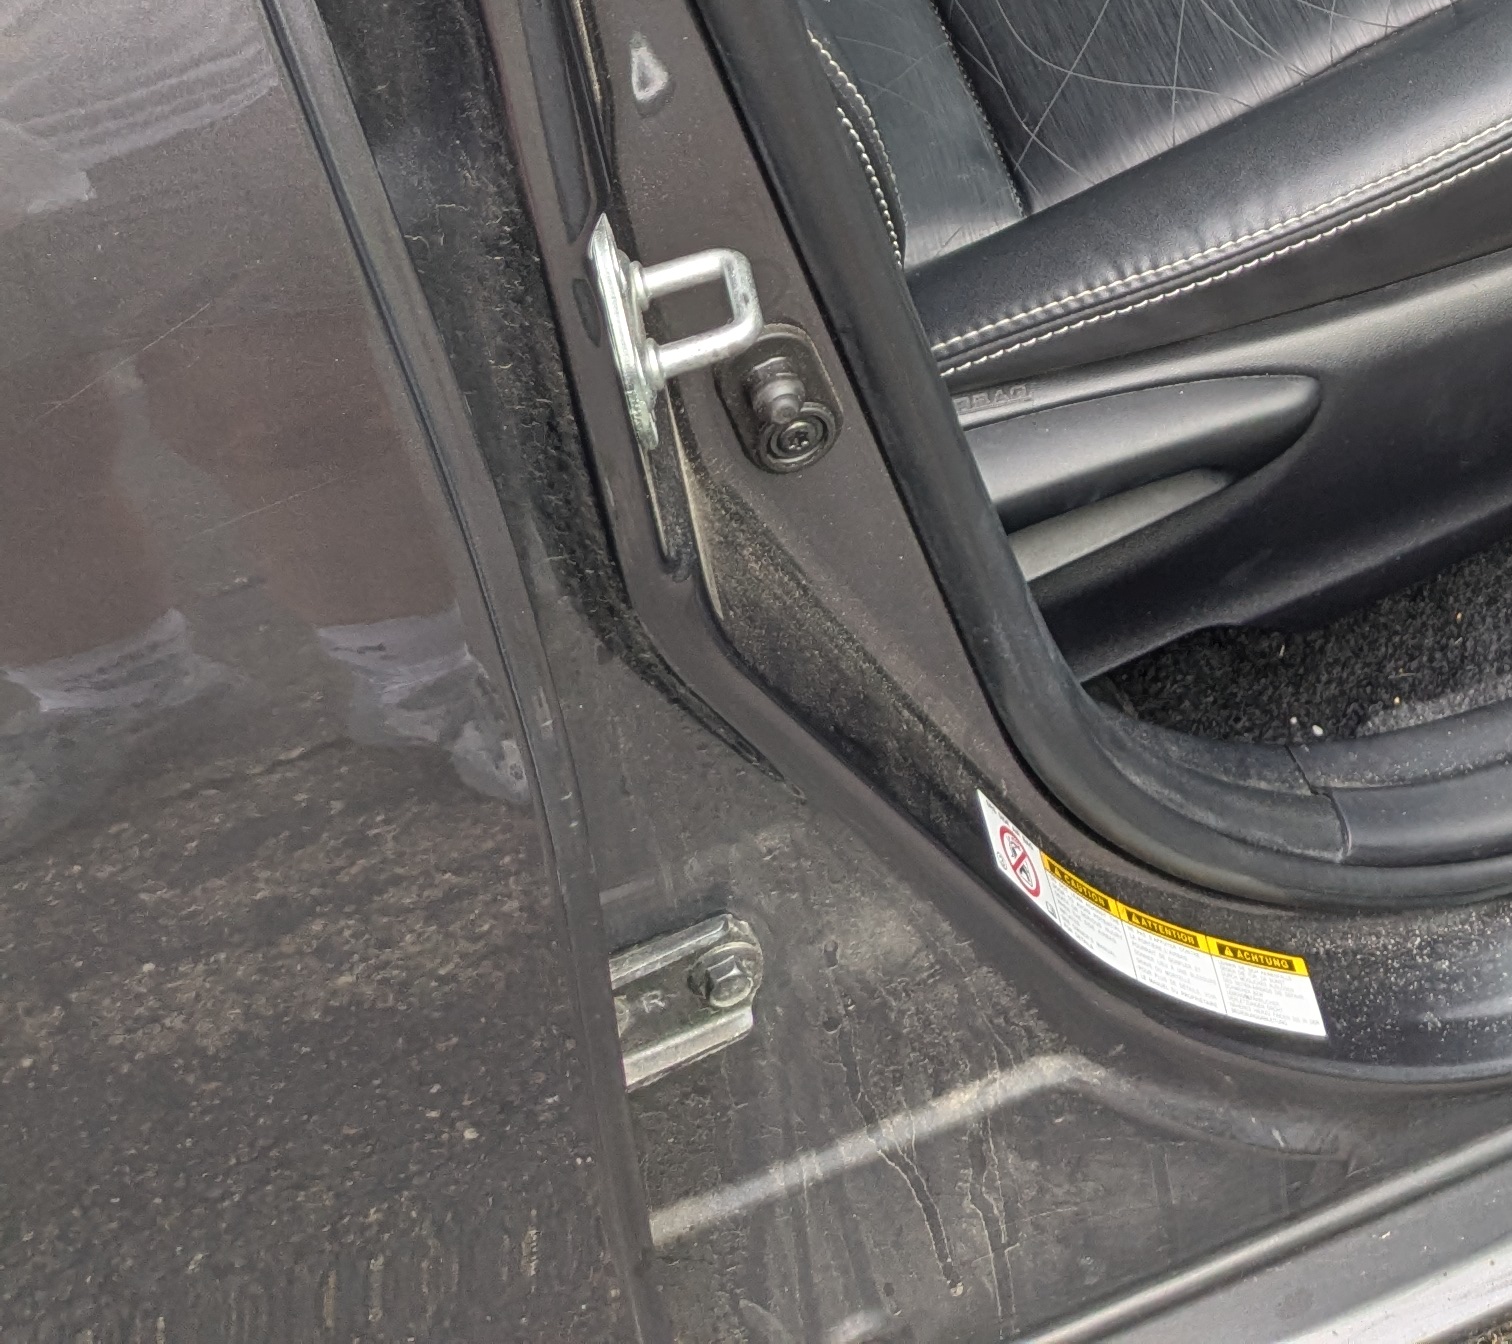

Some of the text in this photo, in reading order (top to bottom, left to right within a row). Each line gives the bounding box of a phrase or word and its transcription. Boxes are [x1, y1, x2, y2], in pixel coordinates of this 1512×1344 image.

[1063, 873, 1106, 907] CAUTION
[1141, 917, 1195, 945] ATTENTION
[1236, 949, 1290, 969] ACHTUNG
